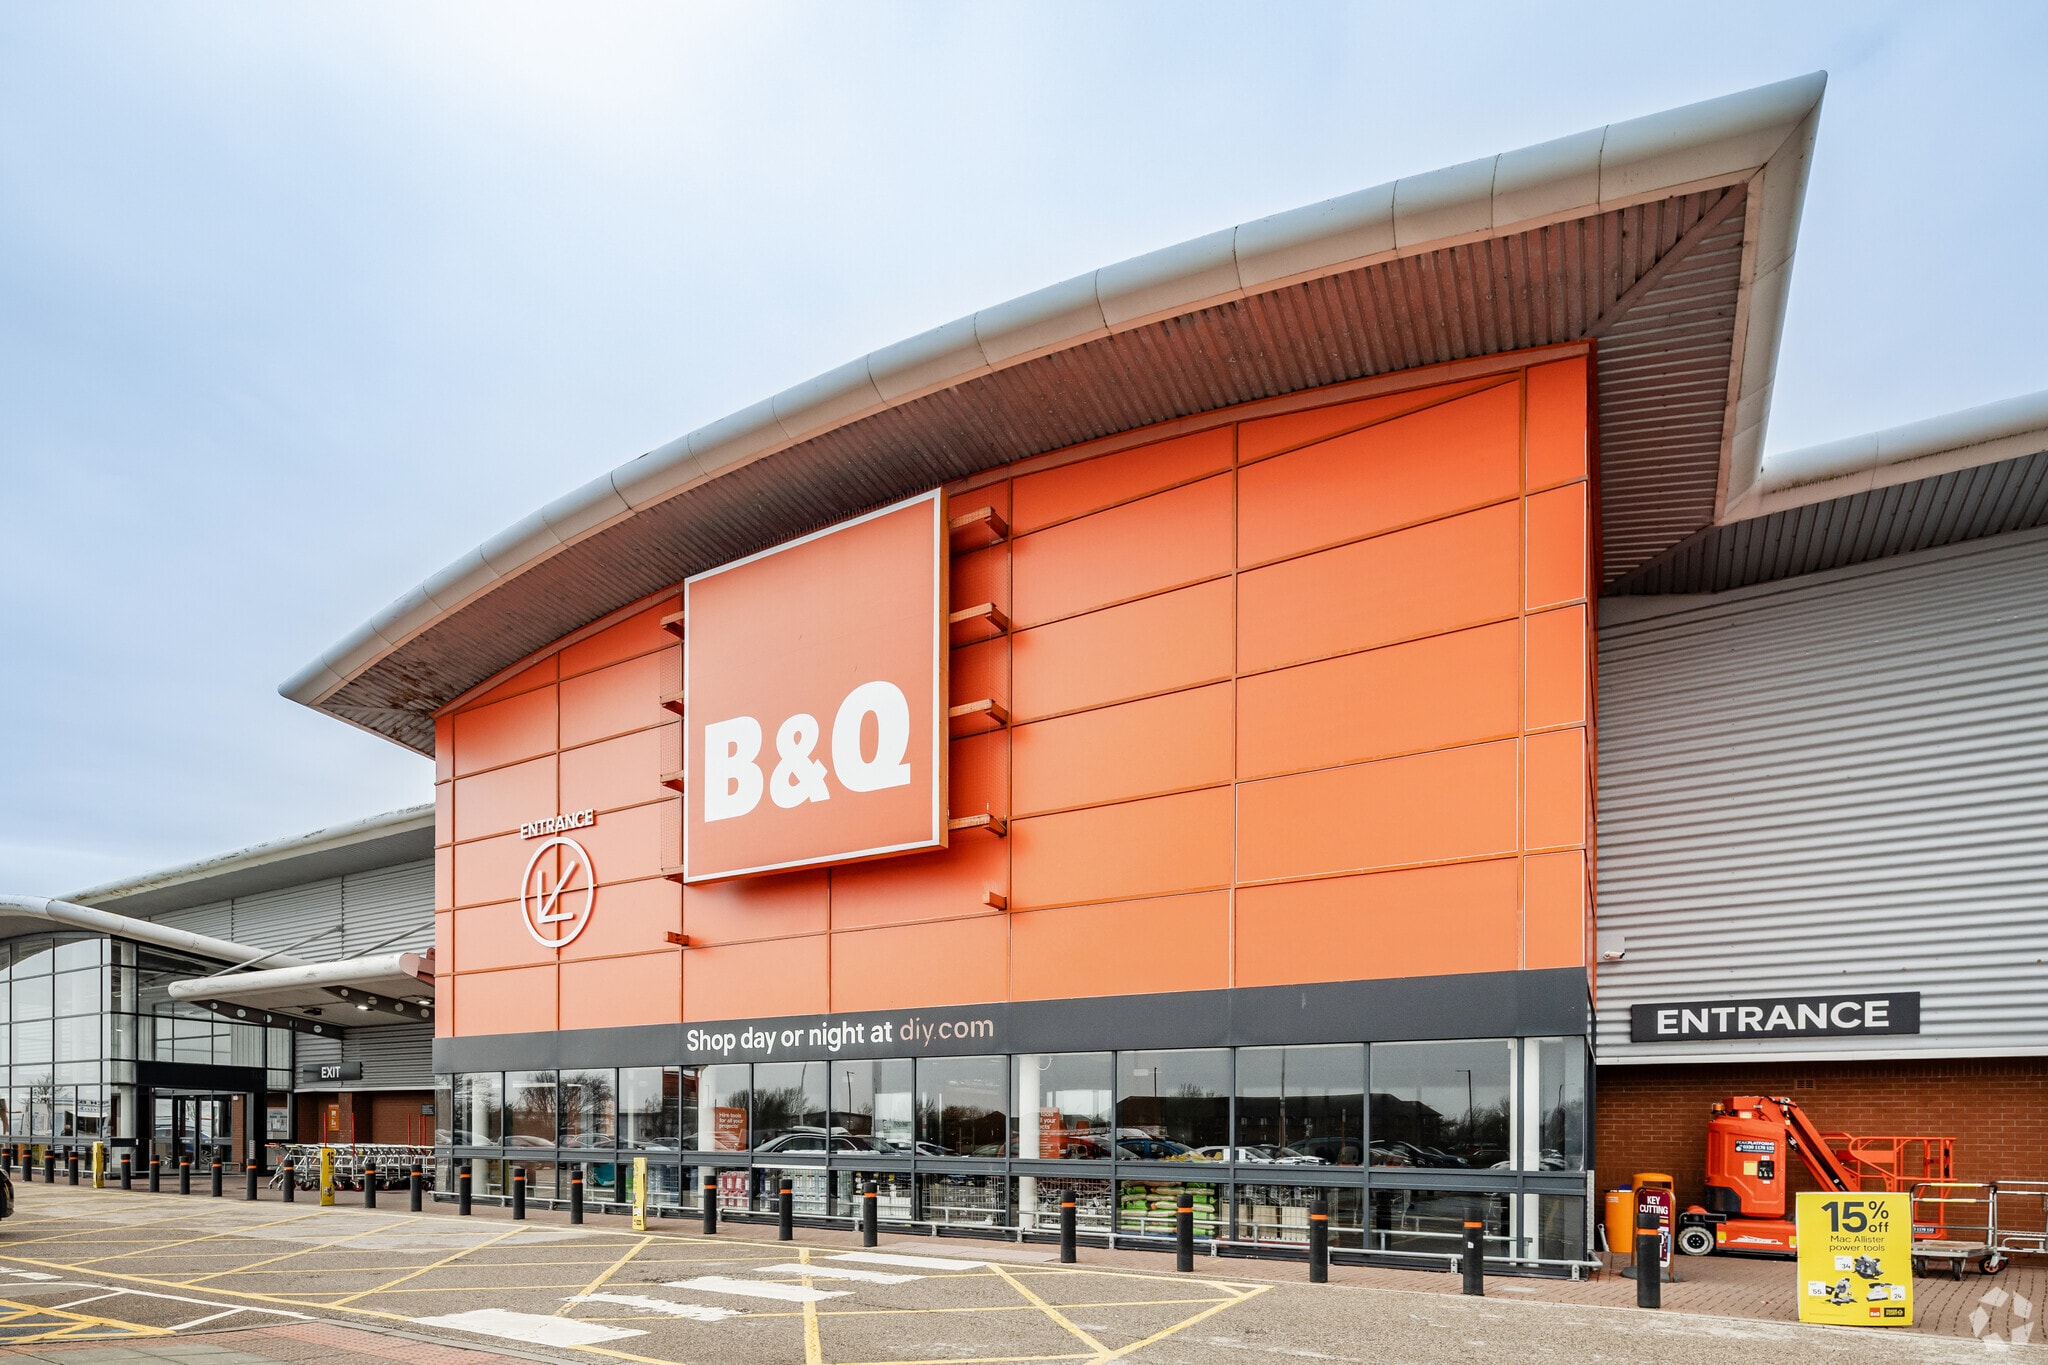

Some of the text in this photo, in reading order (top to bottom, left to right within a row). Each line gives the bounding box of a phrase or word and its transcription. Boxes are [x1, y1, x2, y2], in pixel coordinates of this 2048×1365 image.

[704, 681, 911, 823] B&Q
[520, 808, 594, 839] ENTRANCE
[1657, 1000, 1890, 1035] ENTRANCE
[687, 1017, 994, 1056] Shop day or night at diy.com
[321, 1066, 341, 1079] EXIT
[1646, 1195, 1661, 1205] KEY
[1639, 1204, 1669, 1215] CUTTING
[1868, 1222, 1889, 1233] off
[1830, 1235, 1884, 1243] Mac Allister
[1829, 1244, 1886, 1252] power tools
